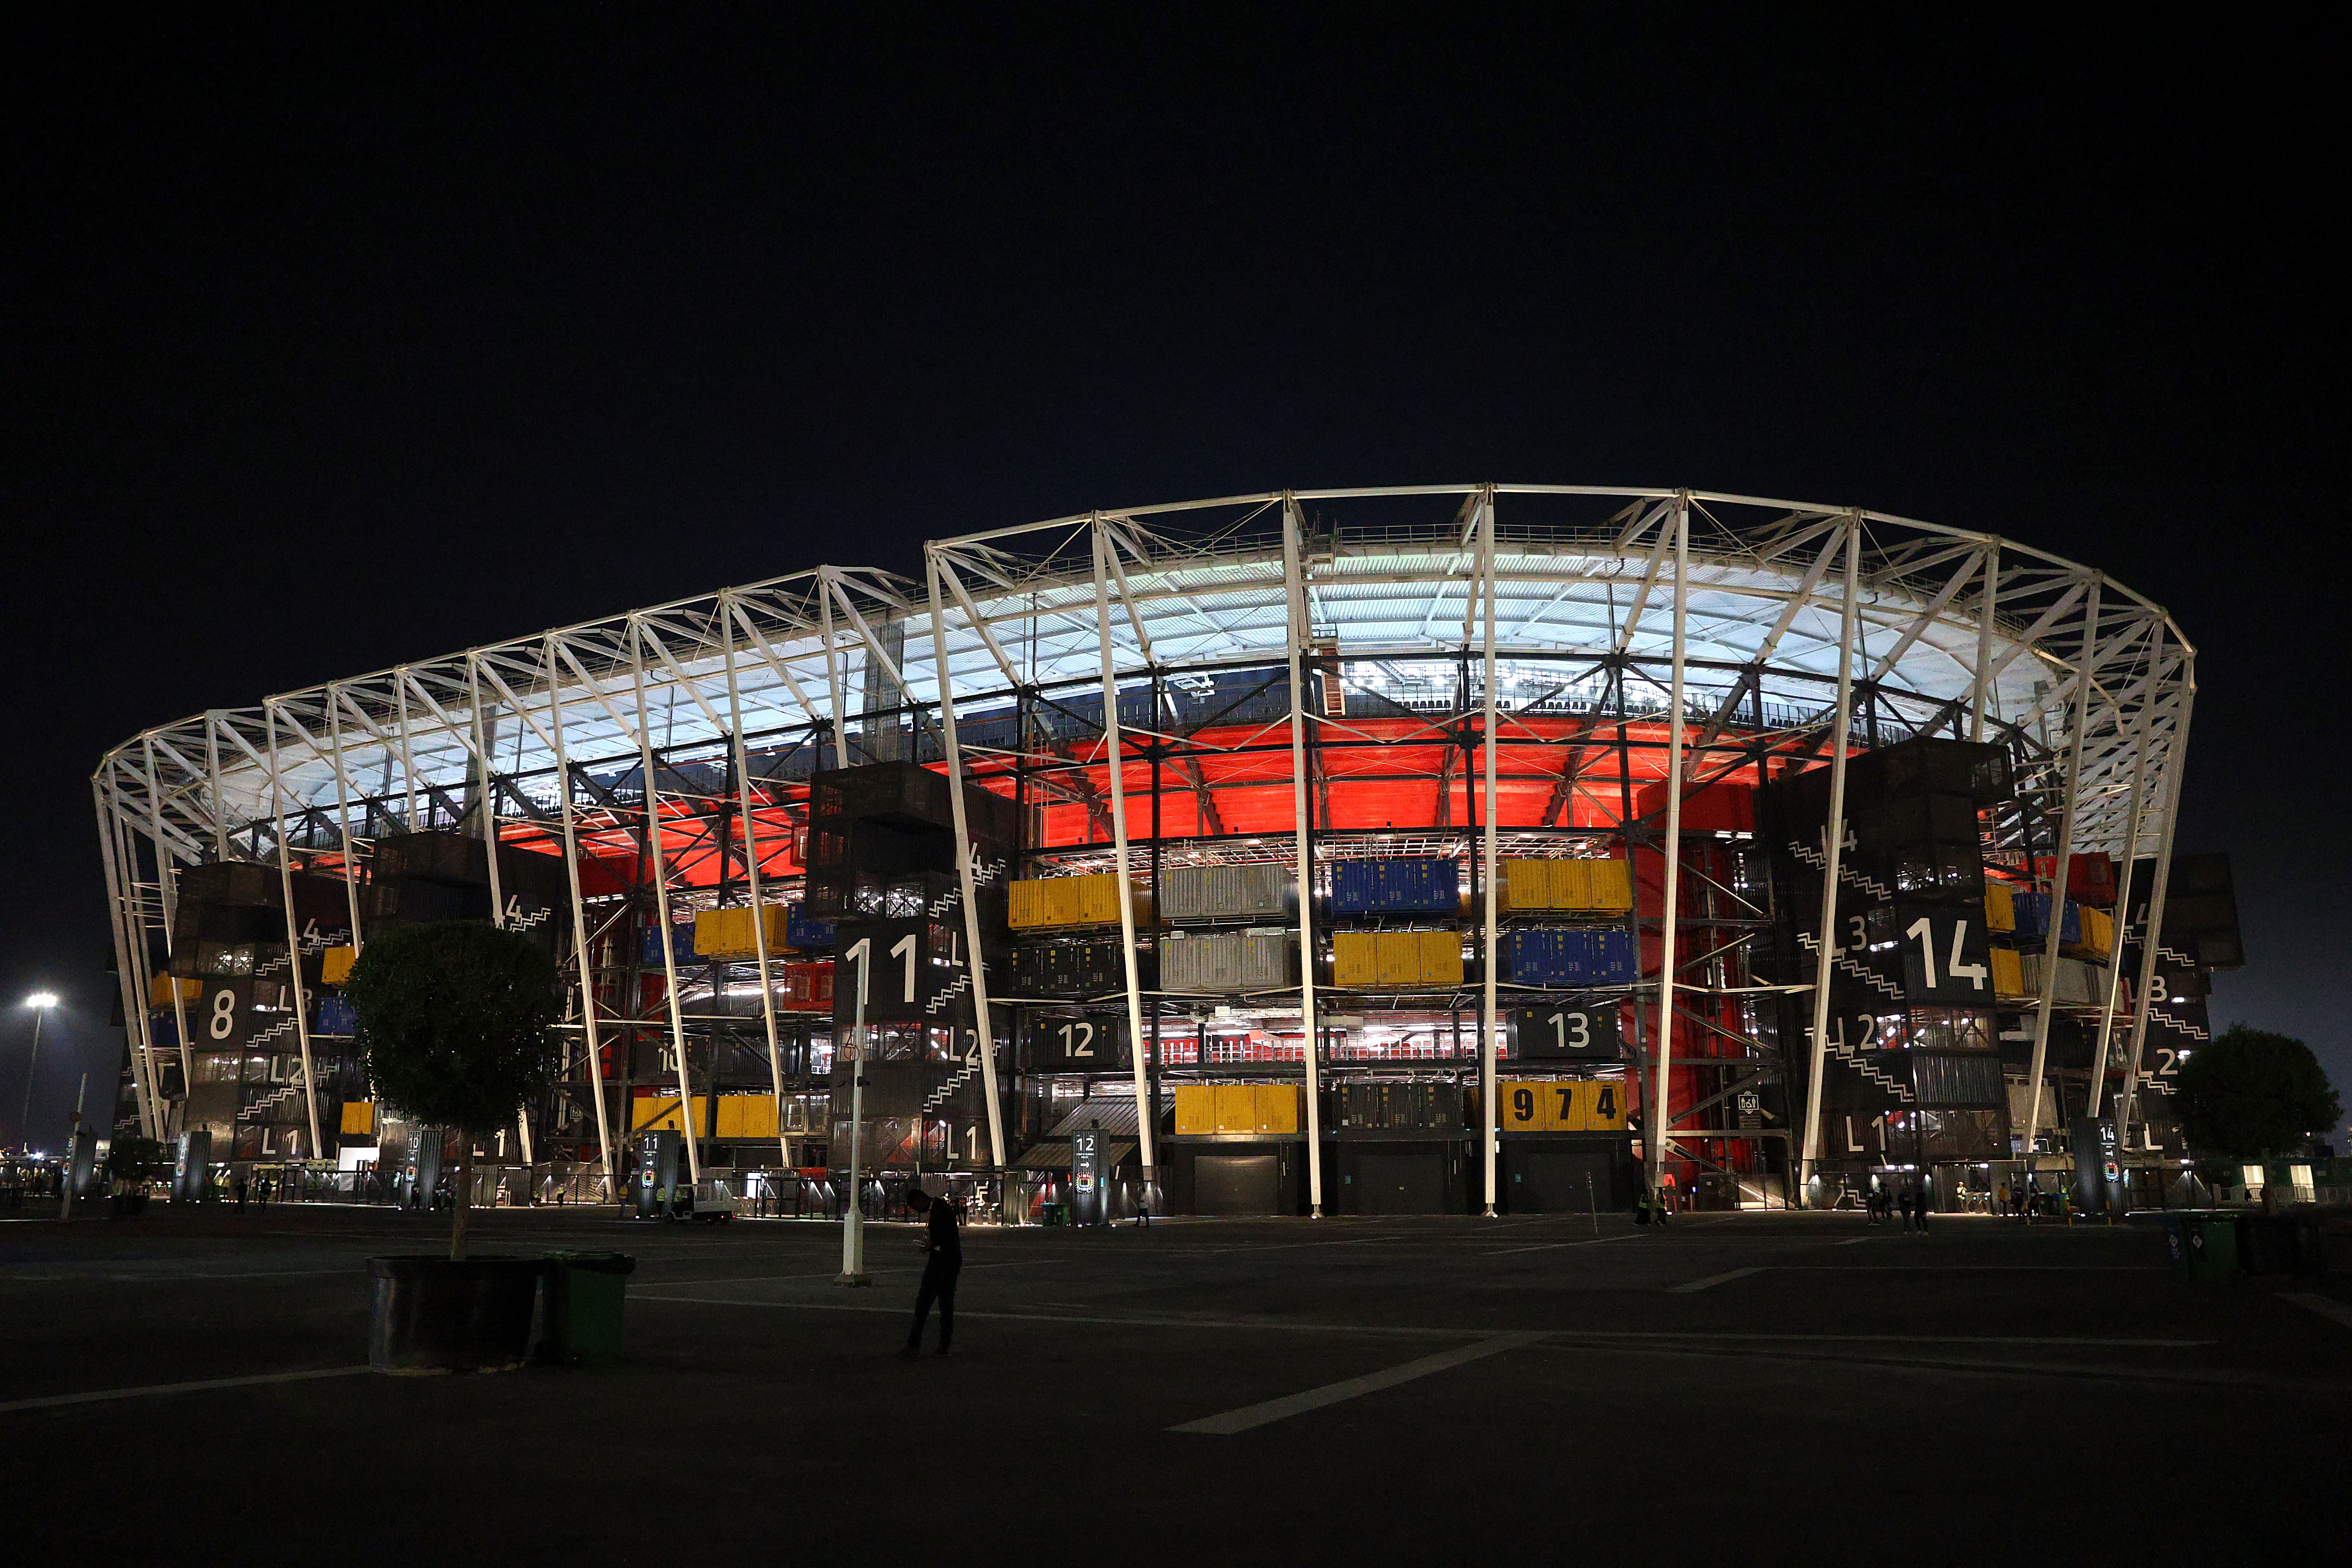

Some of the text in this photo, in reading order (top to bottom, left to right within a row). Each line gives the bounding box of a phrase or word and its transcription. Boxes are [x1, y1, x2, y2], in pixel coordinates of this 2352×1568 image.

[952, 931, 967, 967] L
[1906, 918, 1987, 990] 14
[845, 934, 916, 1005] 11
[210, 989, 235, 1039] 8
[1548, 1012, 1589, 1048] 13
[949, 1026, 979, 1063] L2
[1058, 1023, 1094, 1057] 12
[1838, 1014, 1877, 1054] L2
[270, 1056, 304, 1085] L2
[262, 1128, 298, 1155] L1
[409, 1137, 418, 1148] 10
[644, 1137, 658, 1149] 11
[947, 1124, 976, 1159] L1
[1077, 1138, 1094, 1151] 12
[1846, 1116, 1886, 1152] L1
[2100, 1127, 2114, 1140] 14
